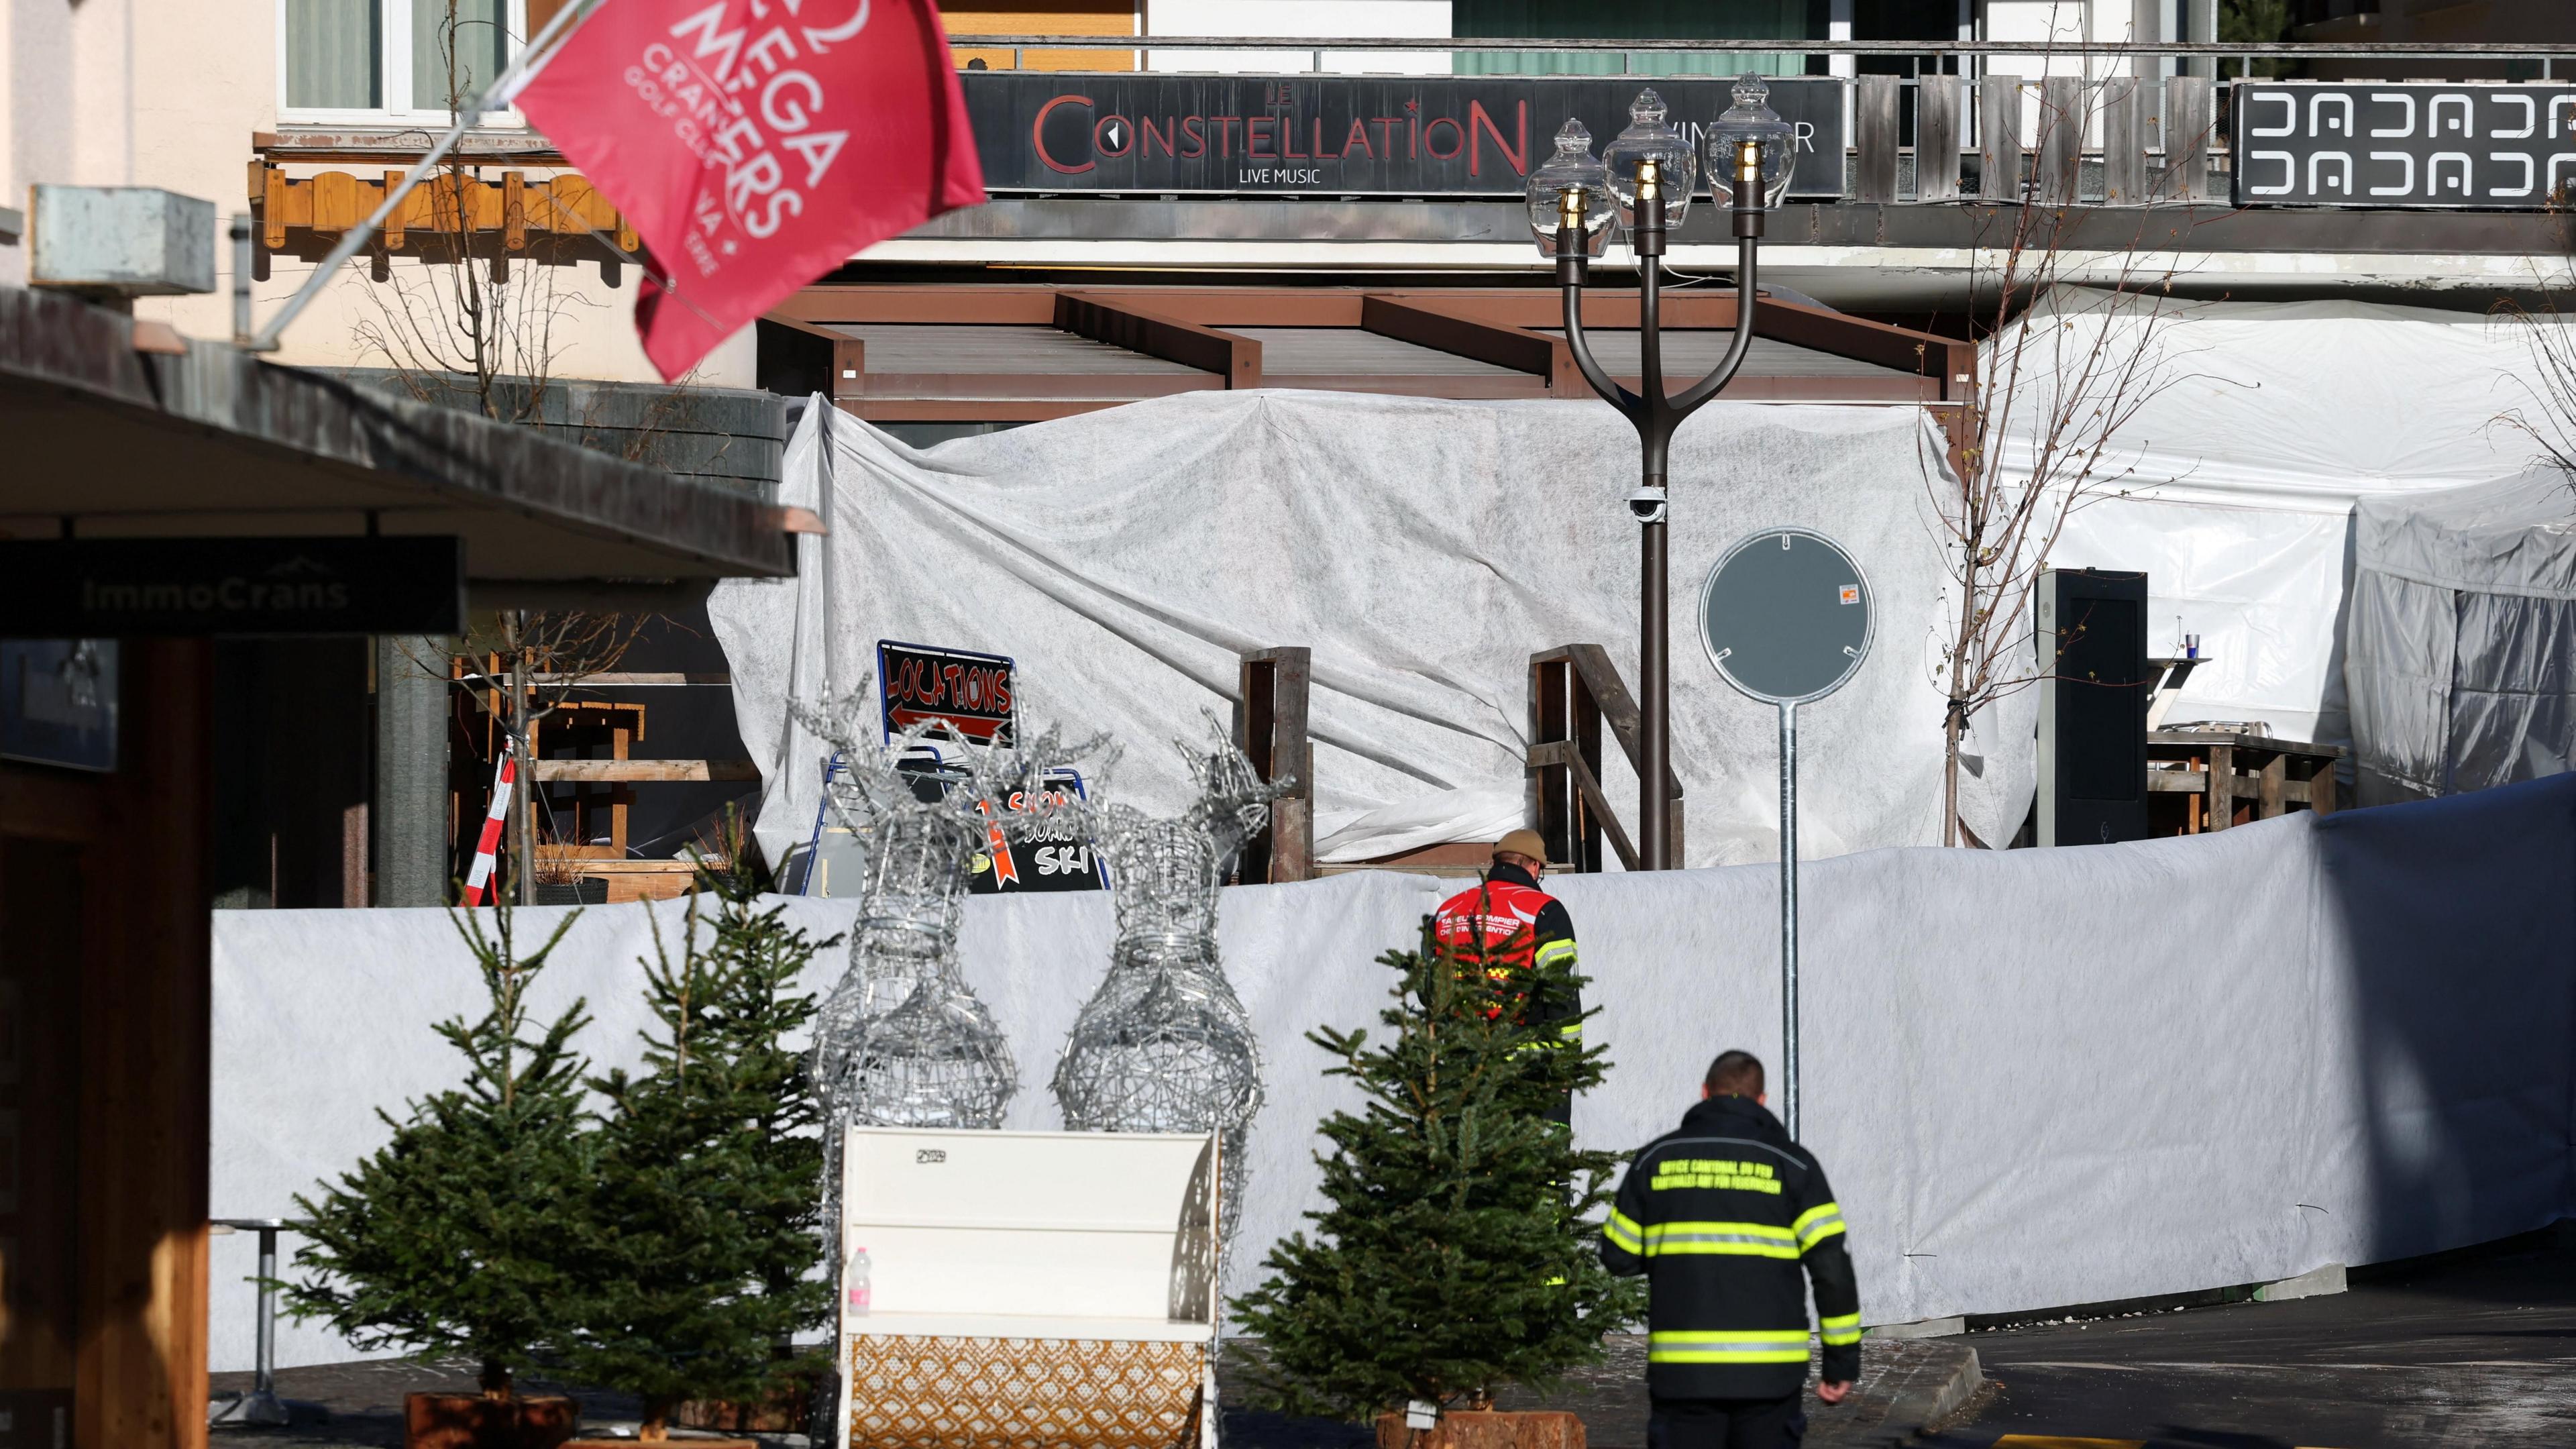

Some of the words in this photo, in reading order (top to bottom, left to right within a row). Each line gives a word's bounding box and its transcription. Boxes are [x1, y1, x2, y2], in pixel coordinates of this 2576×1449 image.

[1266, 85, 1291, 105] LE
[1240, 169, 1271, 184] LIVE
[1275, 168, 1321, 184] MUSIC
[83, 577, 349, 610] ImmoCrans
[885, 655, 1012, 714] LOCATIONS
[1034, 846, 1088, 875] SKI
